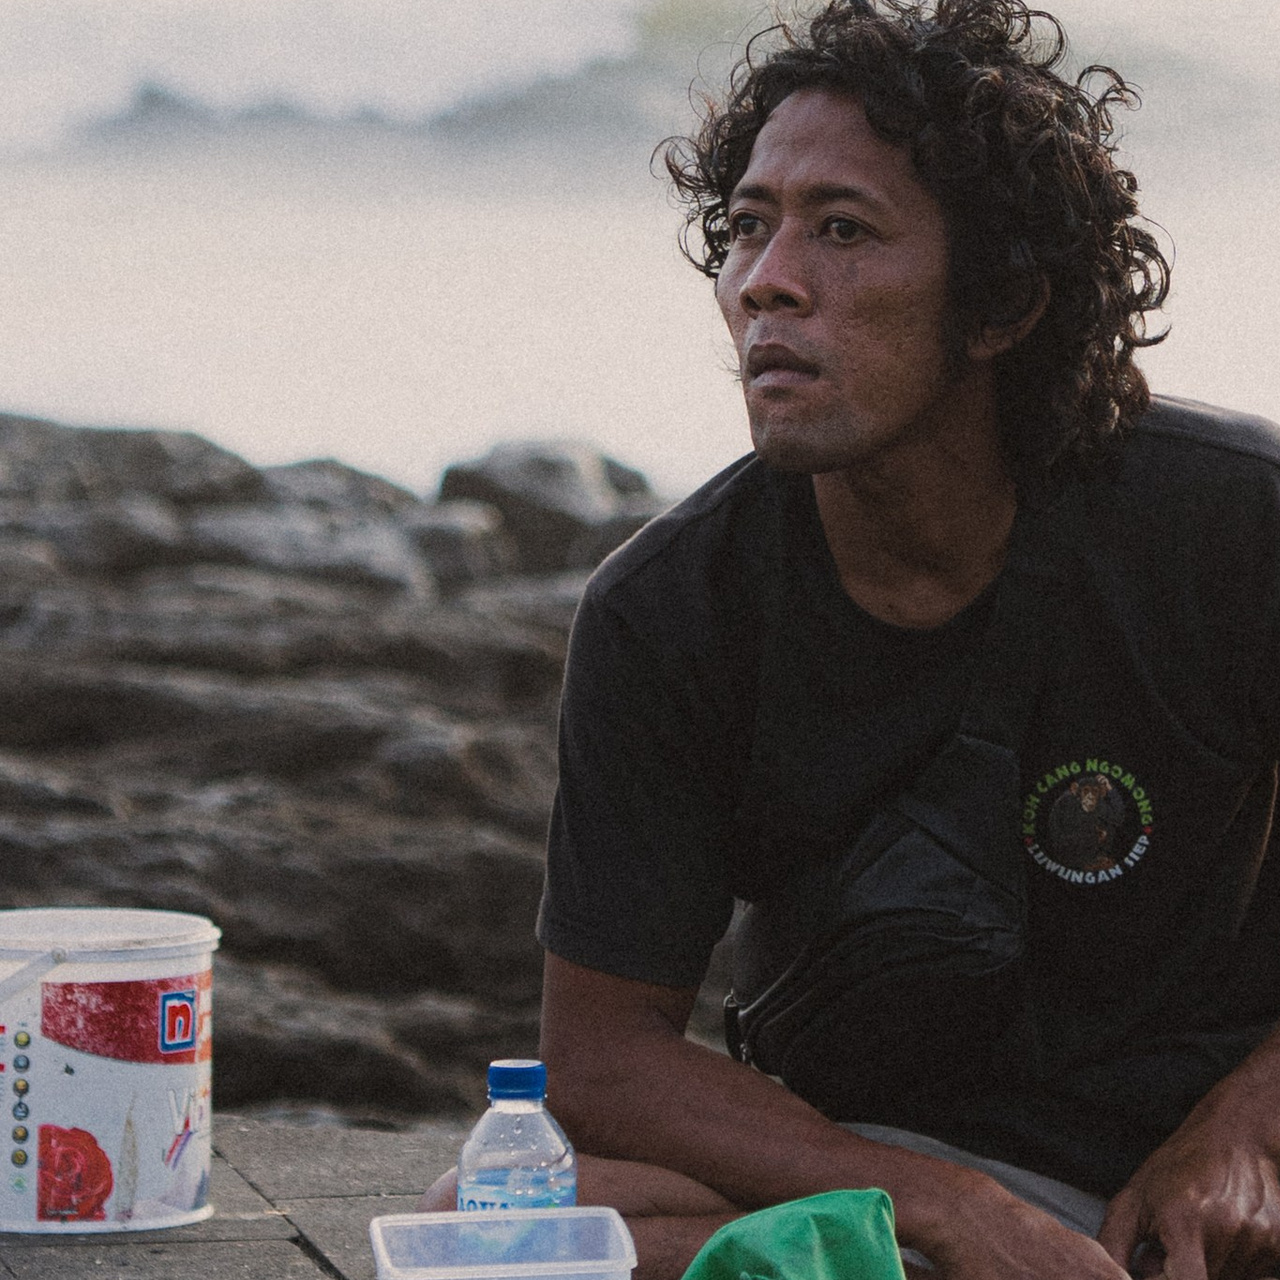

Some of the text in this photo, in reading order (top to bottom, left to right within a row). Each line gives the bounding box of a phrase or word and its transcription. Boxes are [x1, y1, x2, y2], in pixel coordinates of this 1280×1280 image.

[1037, 761, 1082, 793] CANG
[1085, 759, 1153, 825] NGOMONG
[1027, 835, 1150, 884] LUWUNGAN SIEP
